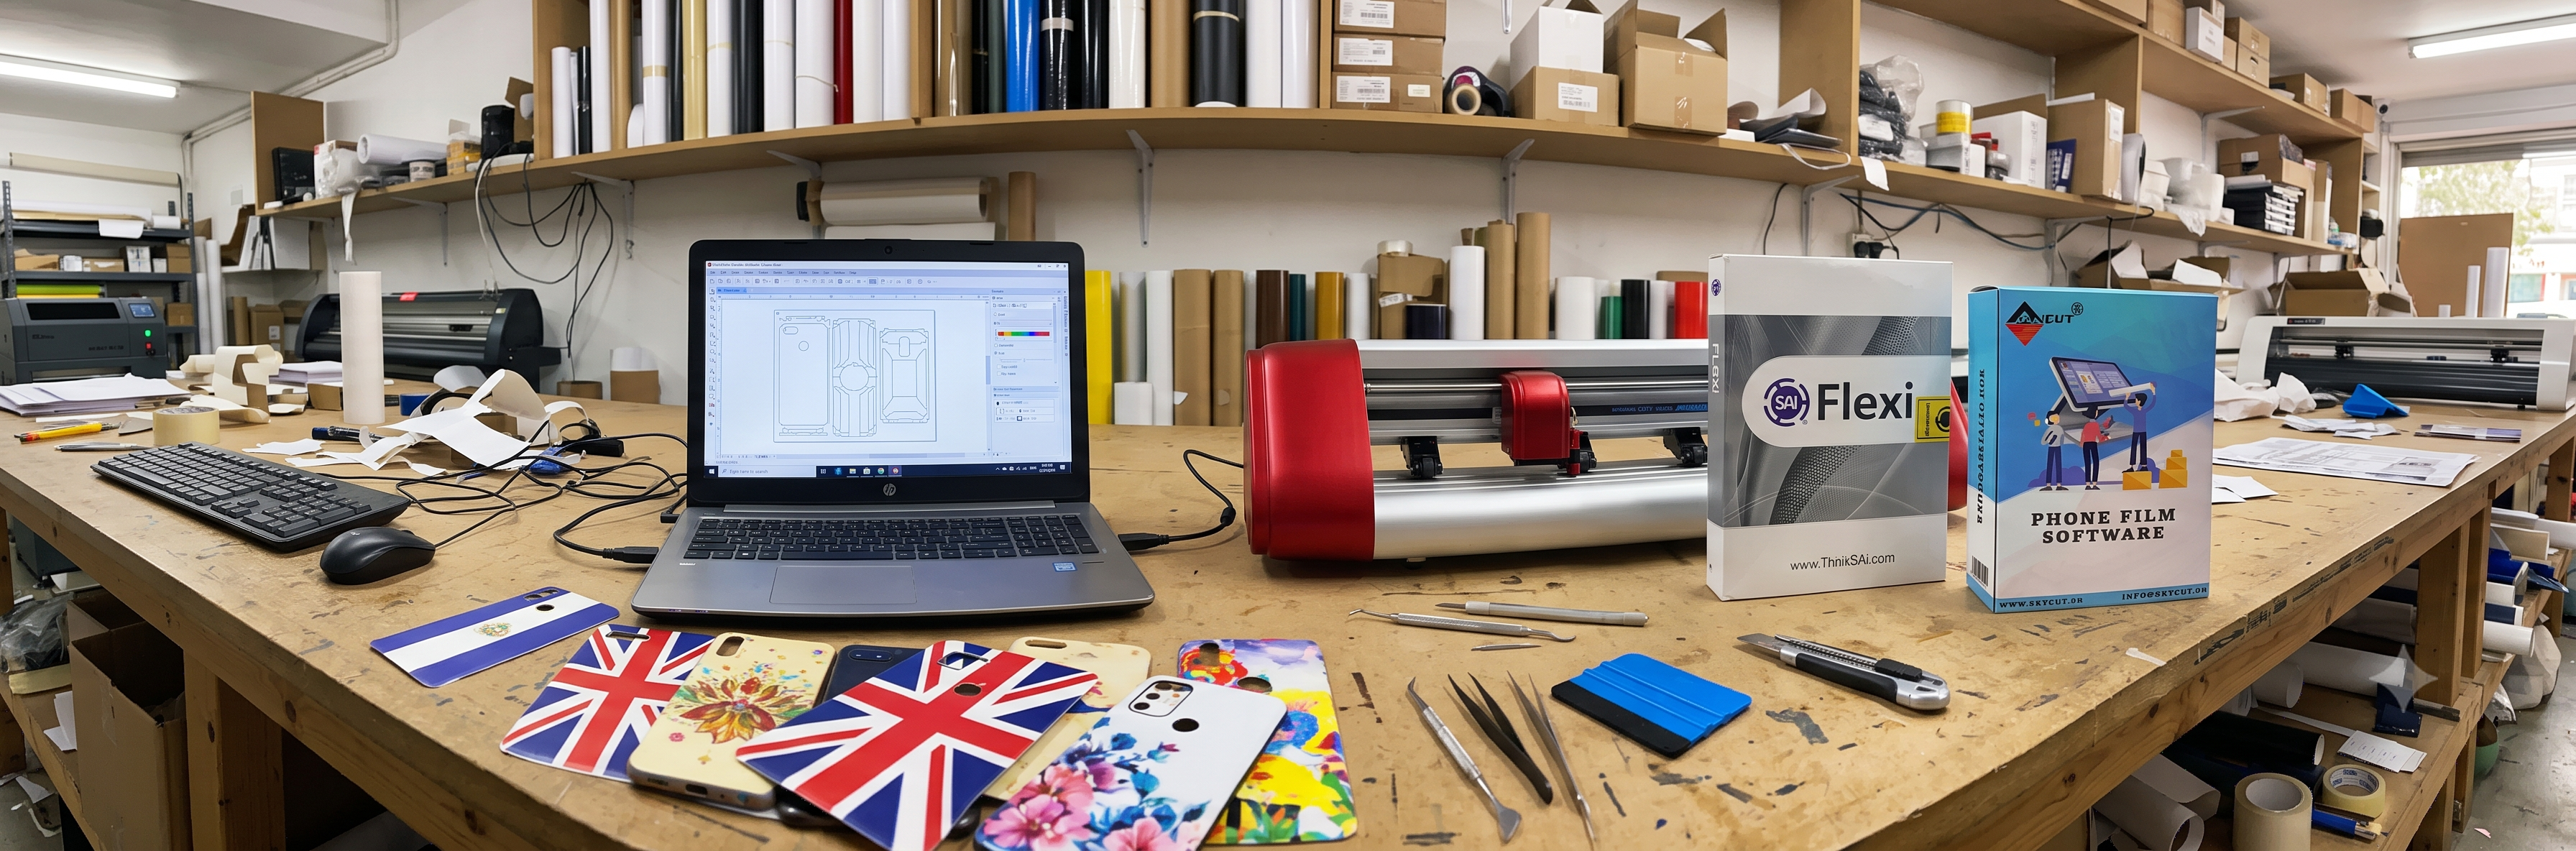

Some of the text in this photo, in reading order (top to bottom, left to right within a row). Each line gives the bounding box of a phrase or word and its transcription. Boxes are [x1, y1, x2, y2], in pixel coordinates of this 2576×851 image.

[1775, 395, 1798, 411] SAI
[1817, 381, 1913, 420] Flexi
[2030, 507, 2176, 526] PHONE FILM
[2042, 526, 2165, 544] SOFTWARE
